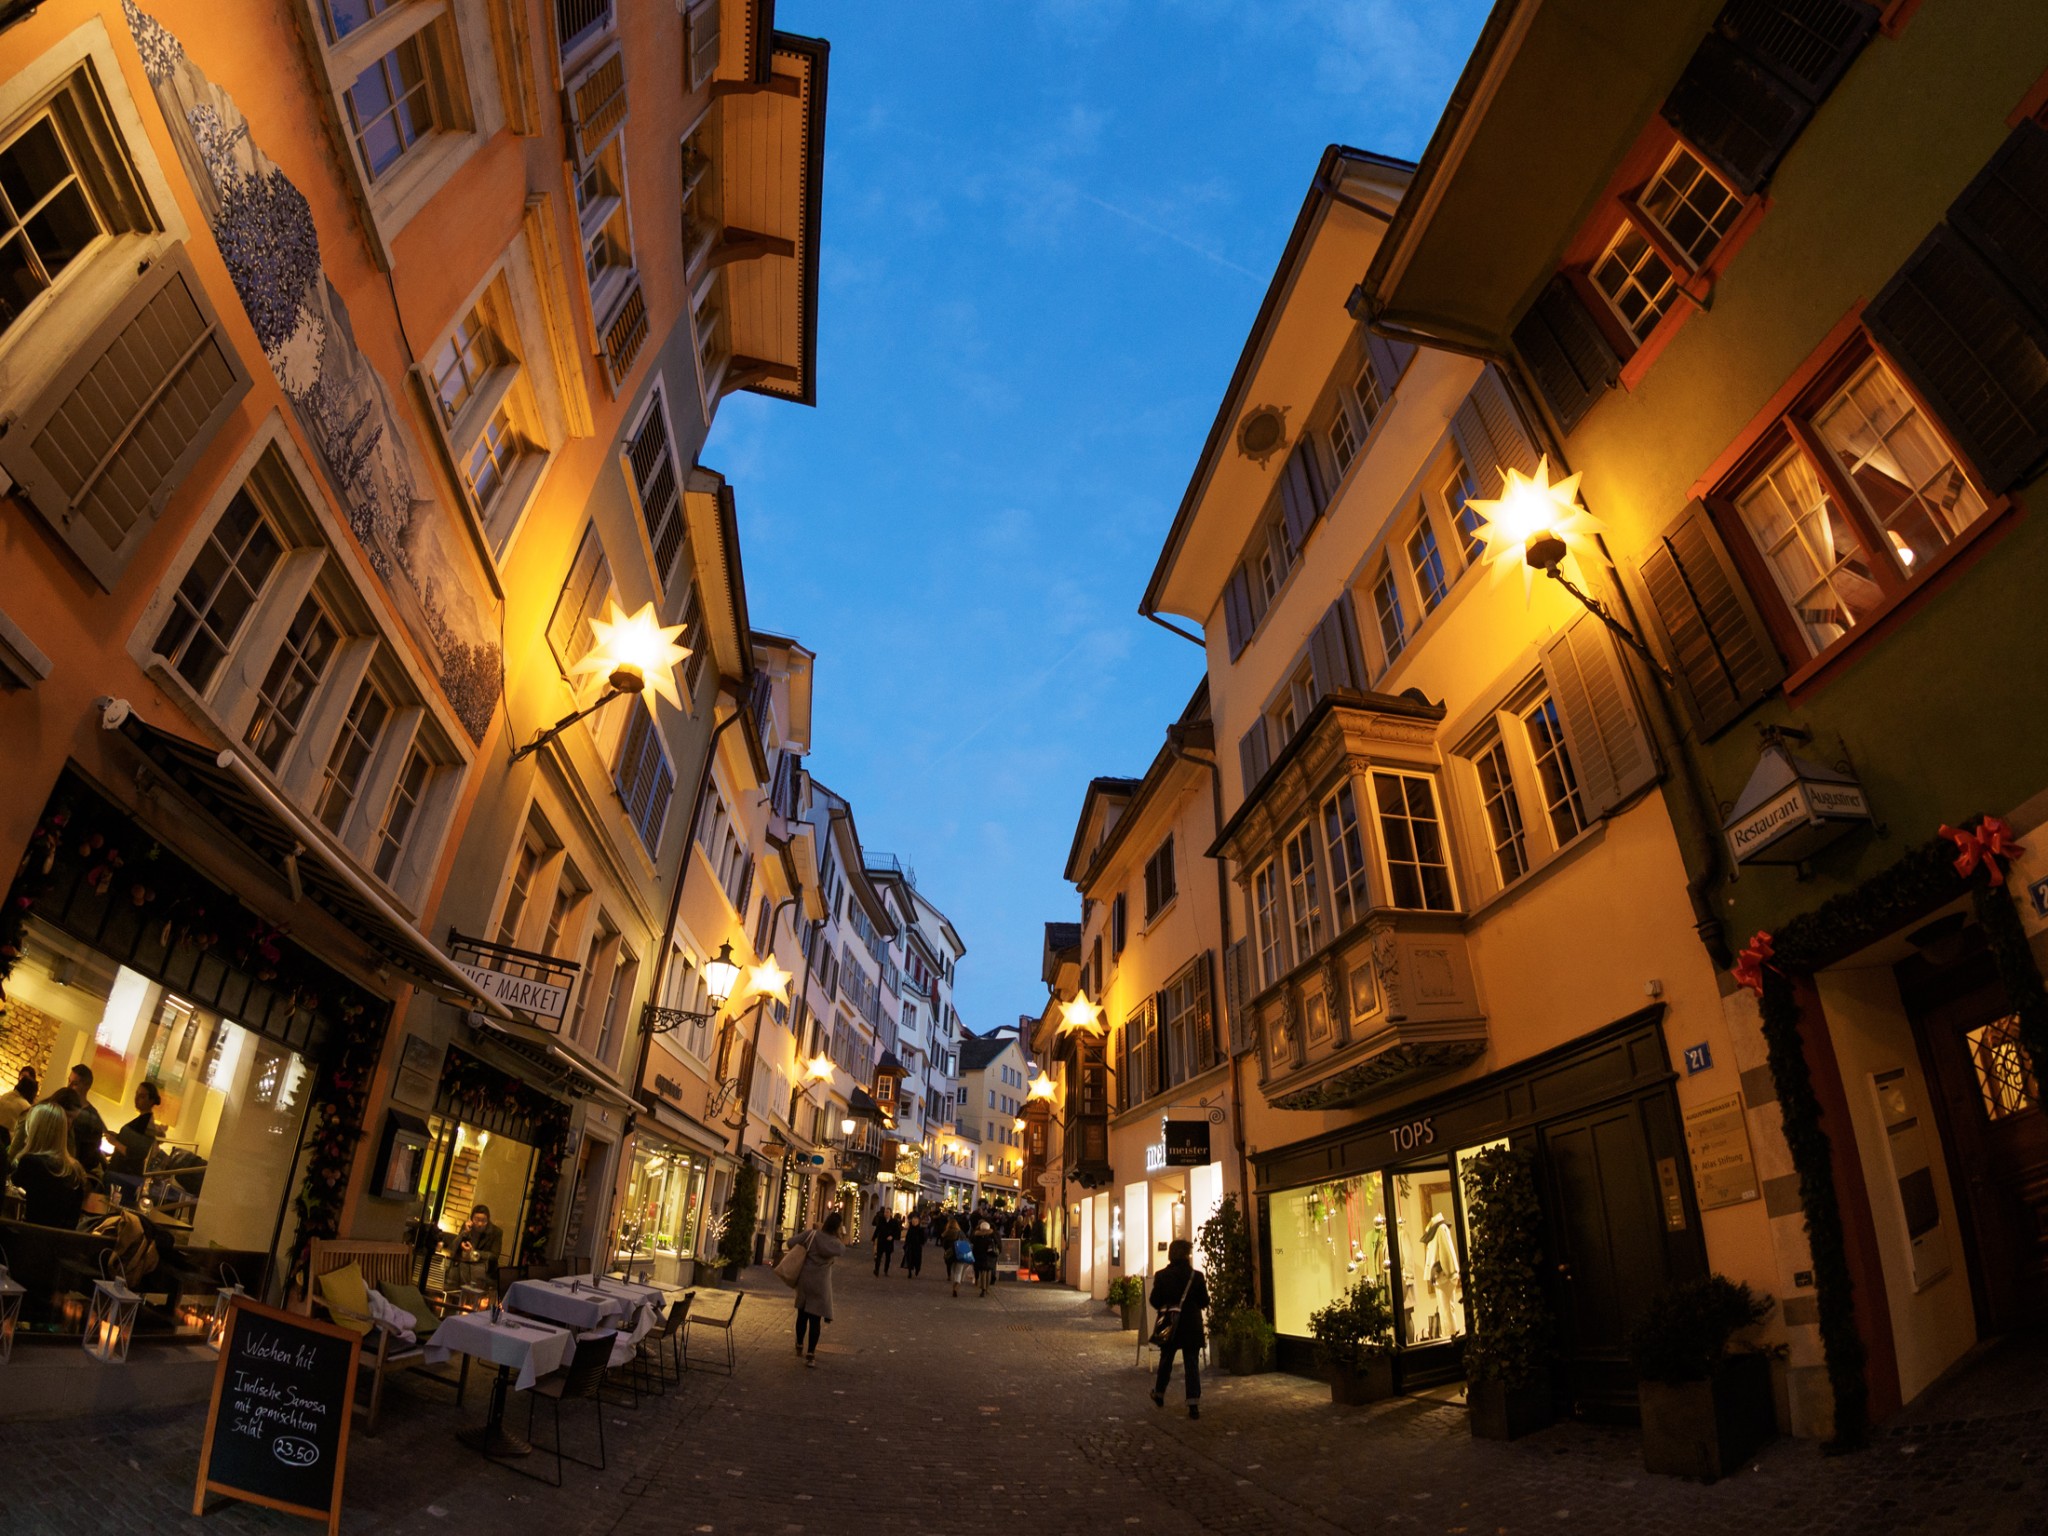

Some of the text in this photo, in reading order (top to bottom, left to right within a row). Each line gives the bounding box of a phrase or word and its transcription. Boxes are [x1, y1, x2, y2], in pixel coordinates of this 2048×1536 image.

[1733, 796, 1800, 848] Restaurant
[495, 977, 561, 1012] MARKET
[1689, 1047, 1704, 1069] 21
[1169, 1146, 1208, 1155] meister
[1389, 1117, 1434, 1153] TOPS
[242, 1332, 291, 1365] Wochen
[234, 1370, 326, 1414] Indische Samosa
[231, 1416, 263, 1439] Salat
[234, 1398, 317, 1434] mit gemischtem
[276, 1439, 315, 1462] 23.50
